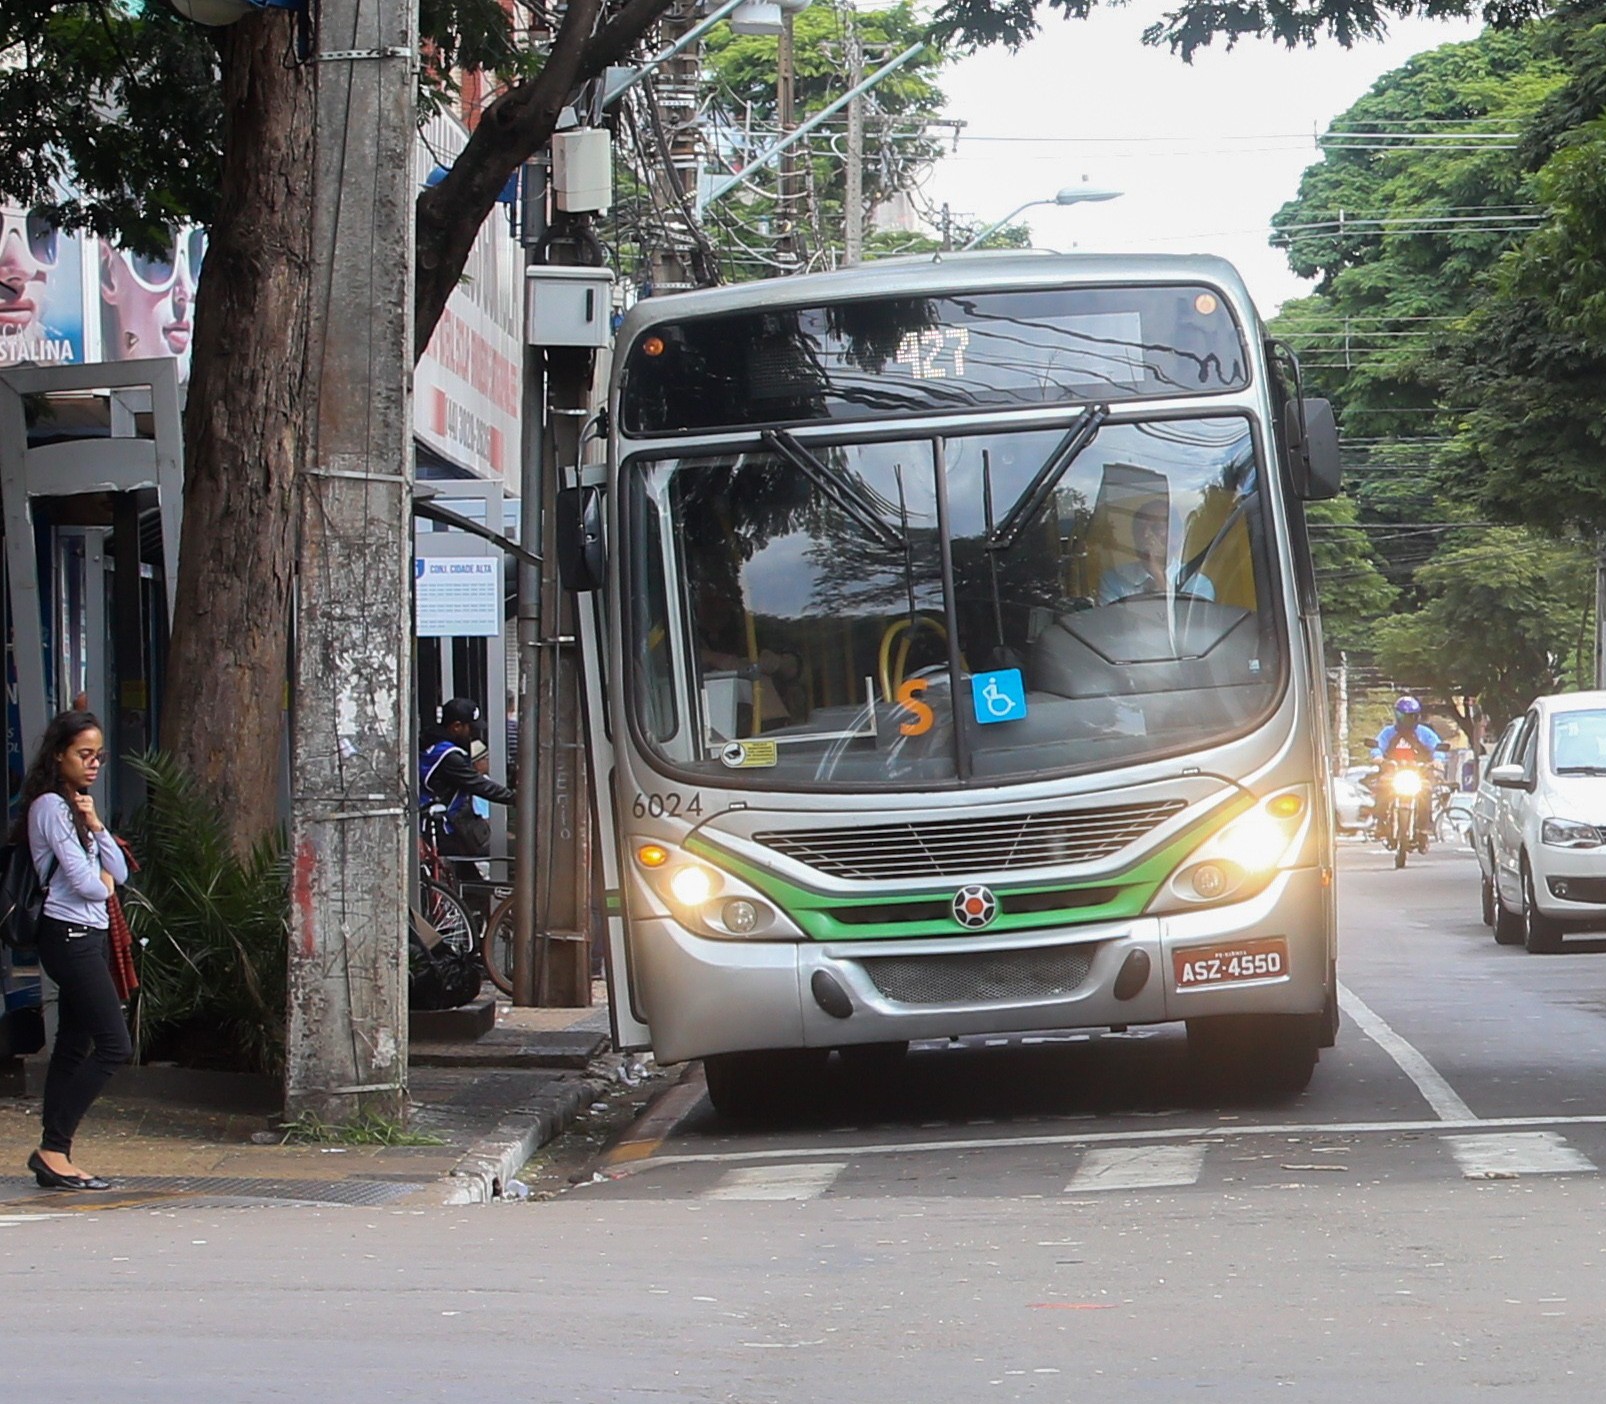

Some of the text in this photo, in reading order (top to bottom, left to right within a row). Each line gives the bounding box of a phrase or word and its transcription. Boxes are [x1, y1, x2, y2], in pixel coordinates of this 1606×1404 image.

[896, 328, 968, 379] 427
[450, 565, 474, 573] CIDADE
[476, 565, 492, 573] ALTA
[633, 792, 703, 819] 6024
